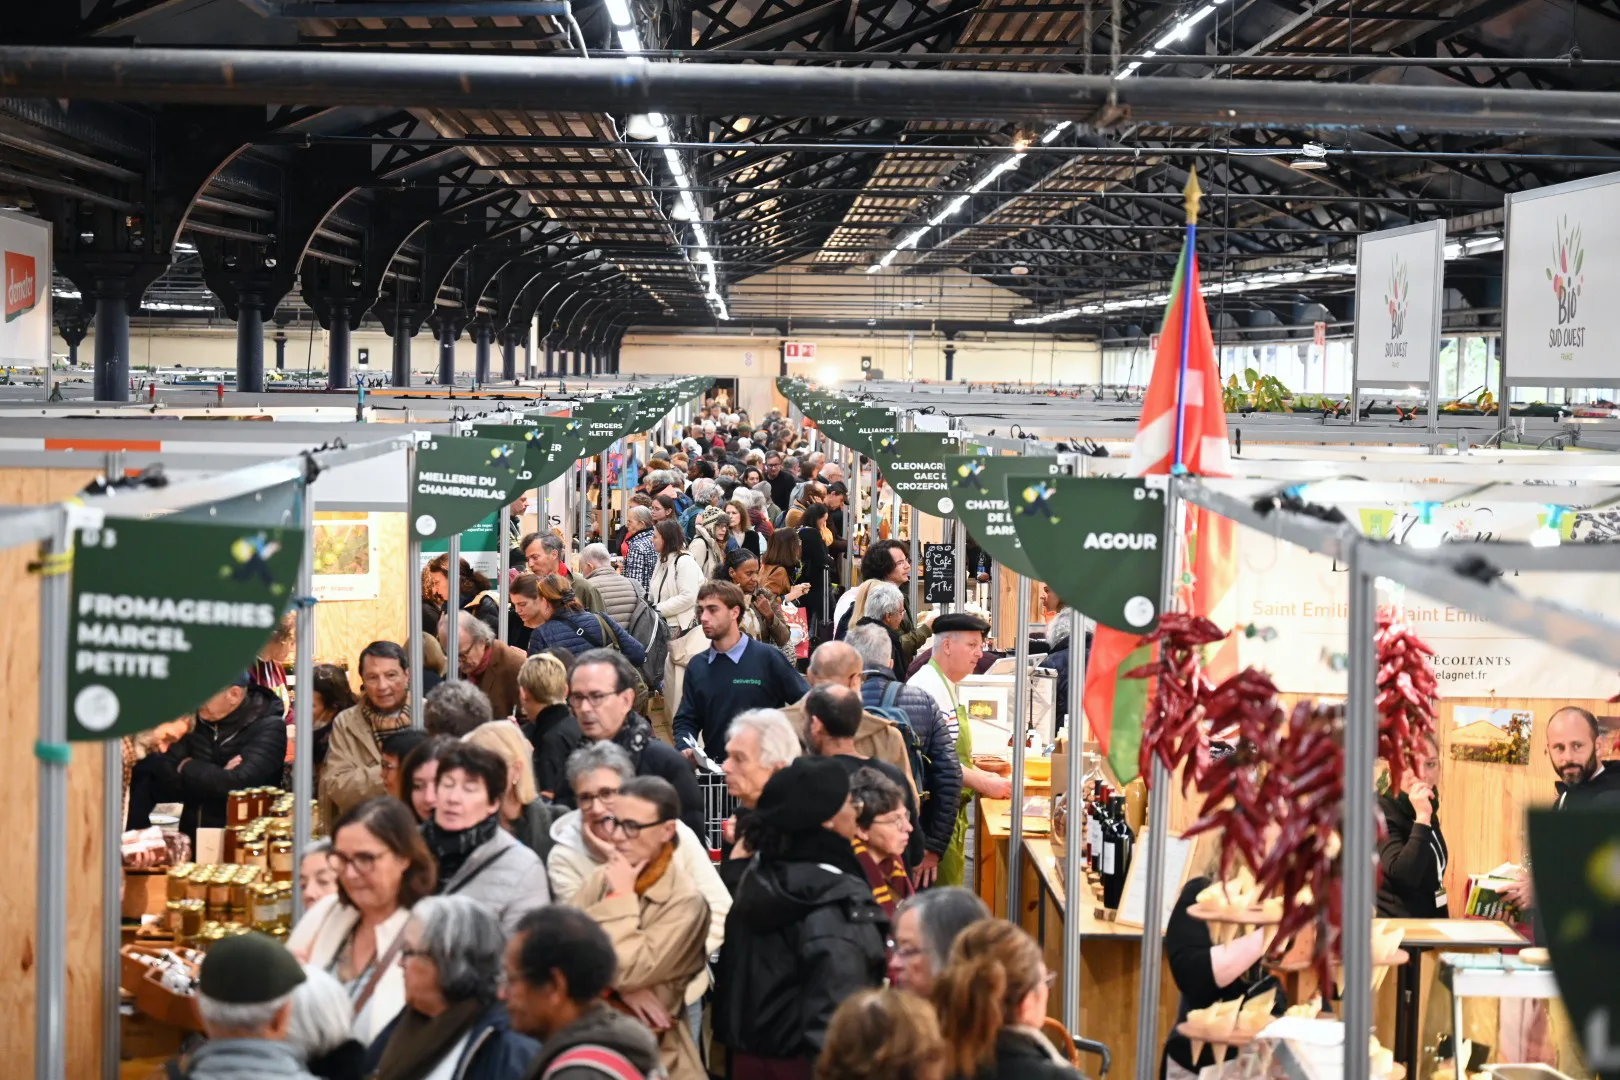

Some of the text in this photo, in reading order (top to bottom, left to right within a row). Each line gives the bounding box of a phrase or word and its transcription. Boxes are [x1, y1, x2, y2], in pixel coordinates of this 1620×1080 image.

[8, 267, 34, 306] demeter
[1549, 326, 1586, 348] SUD OUEST
[360, 352, 367, 360] P
[421, 441, 430, 450] D
[913, 472, 940, 480] GAEC
[1049, 464, 1059, 475] D
[418, 471, 497, 487] MIELLERIE DU
[417, 483, 507, 500] CHAMBOURLAS
[1133, 487, 1159, 501] D 4
[987, 512, 1003, 523] DE
[81, 530, 99, 548] D
[1083, 531, 1157, 550] AGOUR
[932, 552, 952, 568] Café
[936, 580, 952, 592] Thé
[78, 592, 275, 629] FROMAGERIES
[1252, 601, 1297, 617] Saint
[1402, 605, 1439, 621] aint
[77, 622, 192, 651] MARCEL
[75, 650, 170, 679] PETITE
[1433, 670, 1488, 681] elagnet.fr
